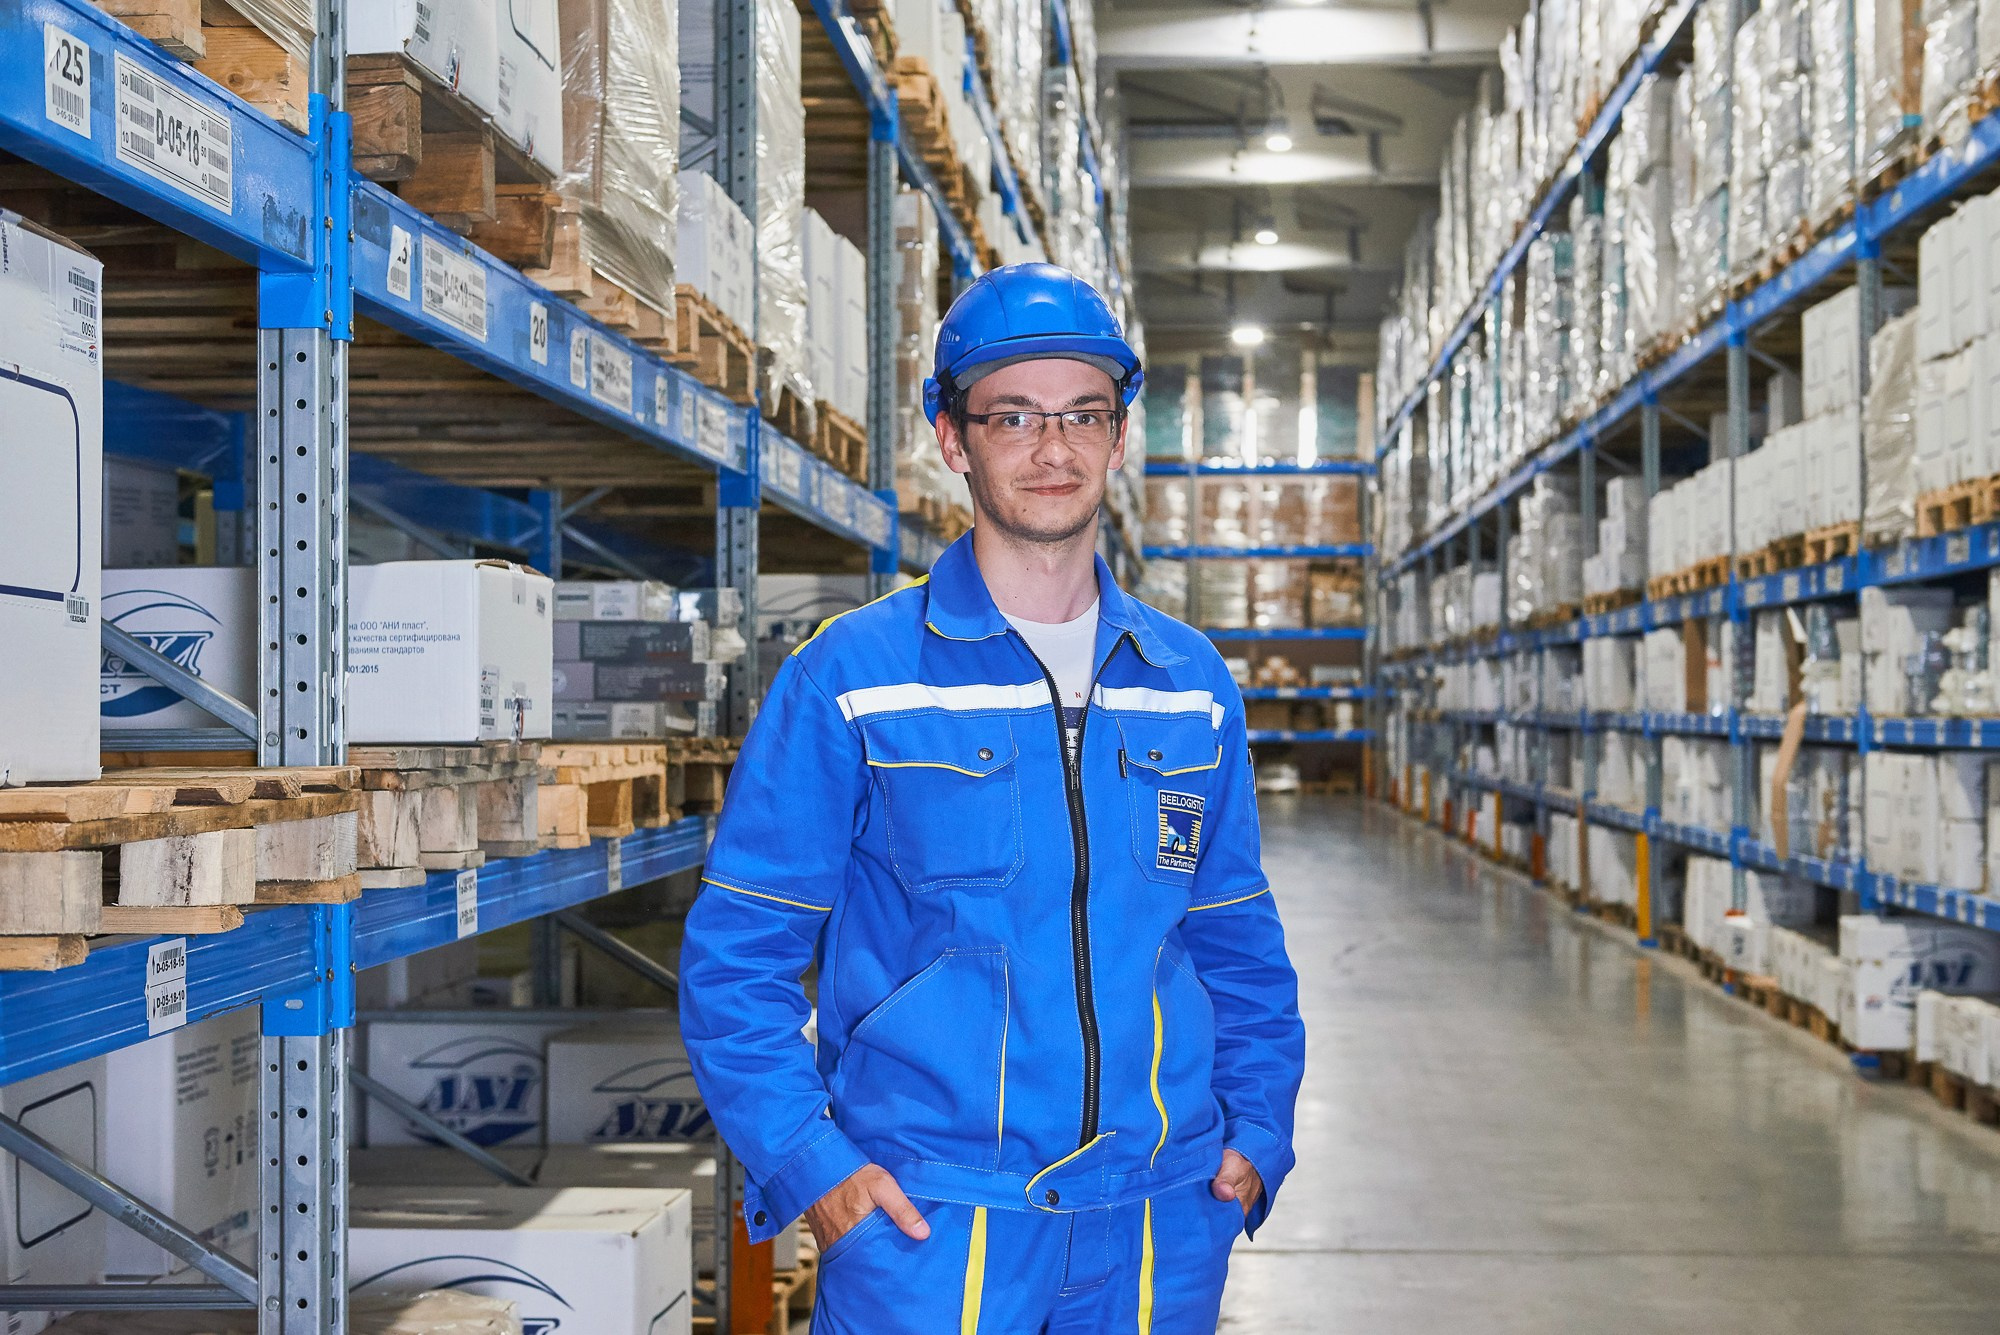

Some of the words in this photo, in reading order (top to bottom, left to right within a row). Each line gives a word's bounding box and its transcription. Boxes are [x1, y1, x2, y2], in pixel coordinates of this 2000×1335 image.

[61, 38, 83, 86] 25
[121, 73, 128, 87] 30
[121, 101, 129, 112] 20
[122, 131, 129, 144] 10
[156, 108, 200, 166] D-05-18
[533, 316, 546, 348] 20
[389, 633, 461, 643] сертифицирована
[381, 646, 425, 655] стандартов
[1159, 856, 1170, 866] The
[156, 956, 185, 974] D-05-18-15
[156, 990, 185, 1008] D-05-18-10
